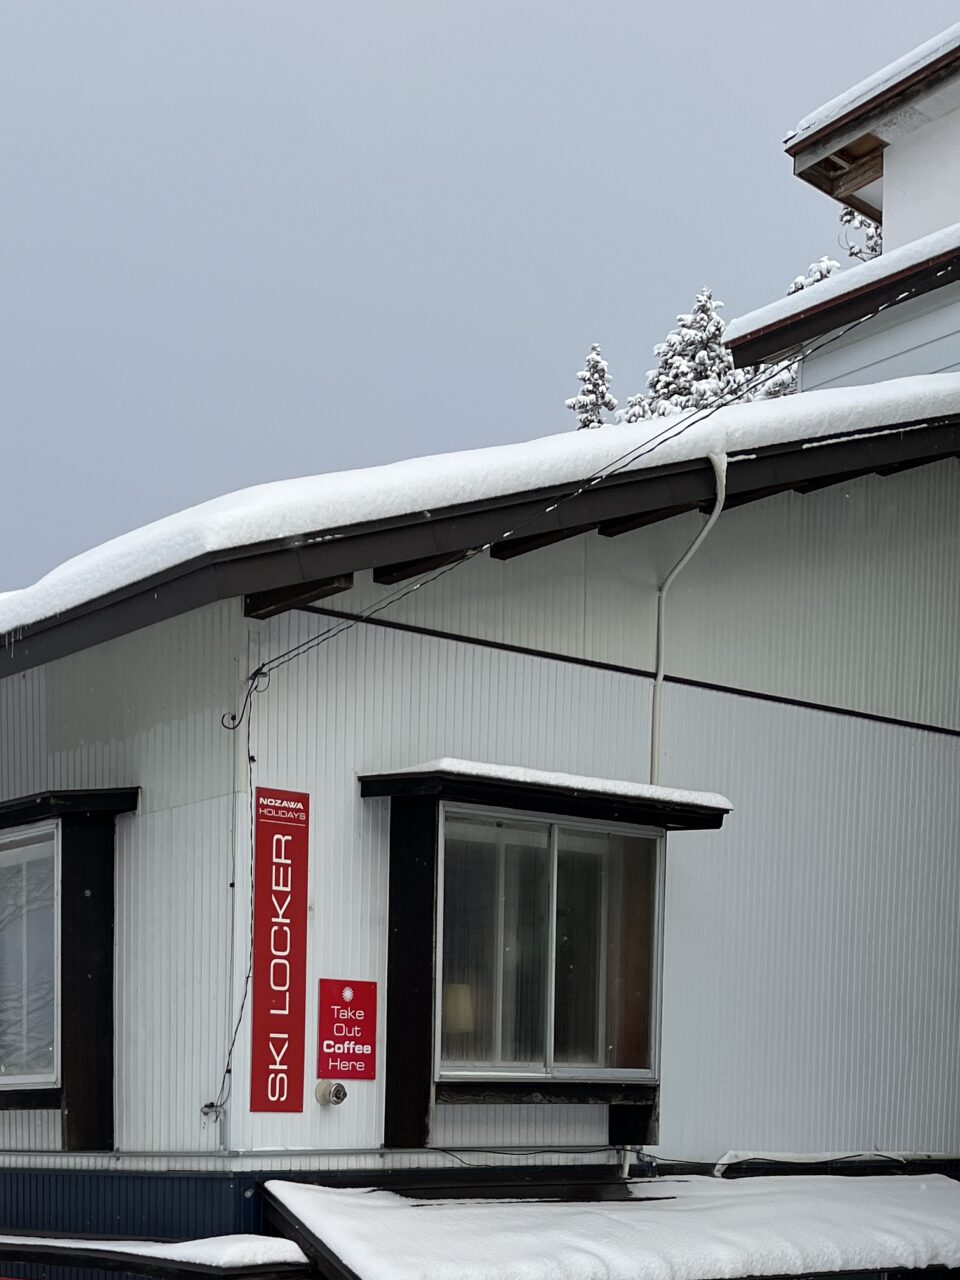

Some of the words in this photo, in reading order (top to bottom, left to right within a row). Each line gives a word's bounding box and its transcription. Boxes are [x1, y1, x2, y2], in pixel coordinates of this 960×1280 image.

[259, 797, 304, 810] NOZAWA
[259, 806, 306, 820] HOLIDAYS
[269, 833, 292, 1015] LOCKER
[331, 1006, 365, 1020] Take
[333, 1023, 362, 1037] Out
[323, 1040, 372, 1054] Coffee
[267, 1033, 289, 1102] SKI
[328, 1058, 365, 1071] Here
